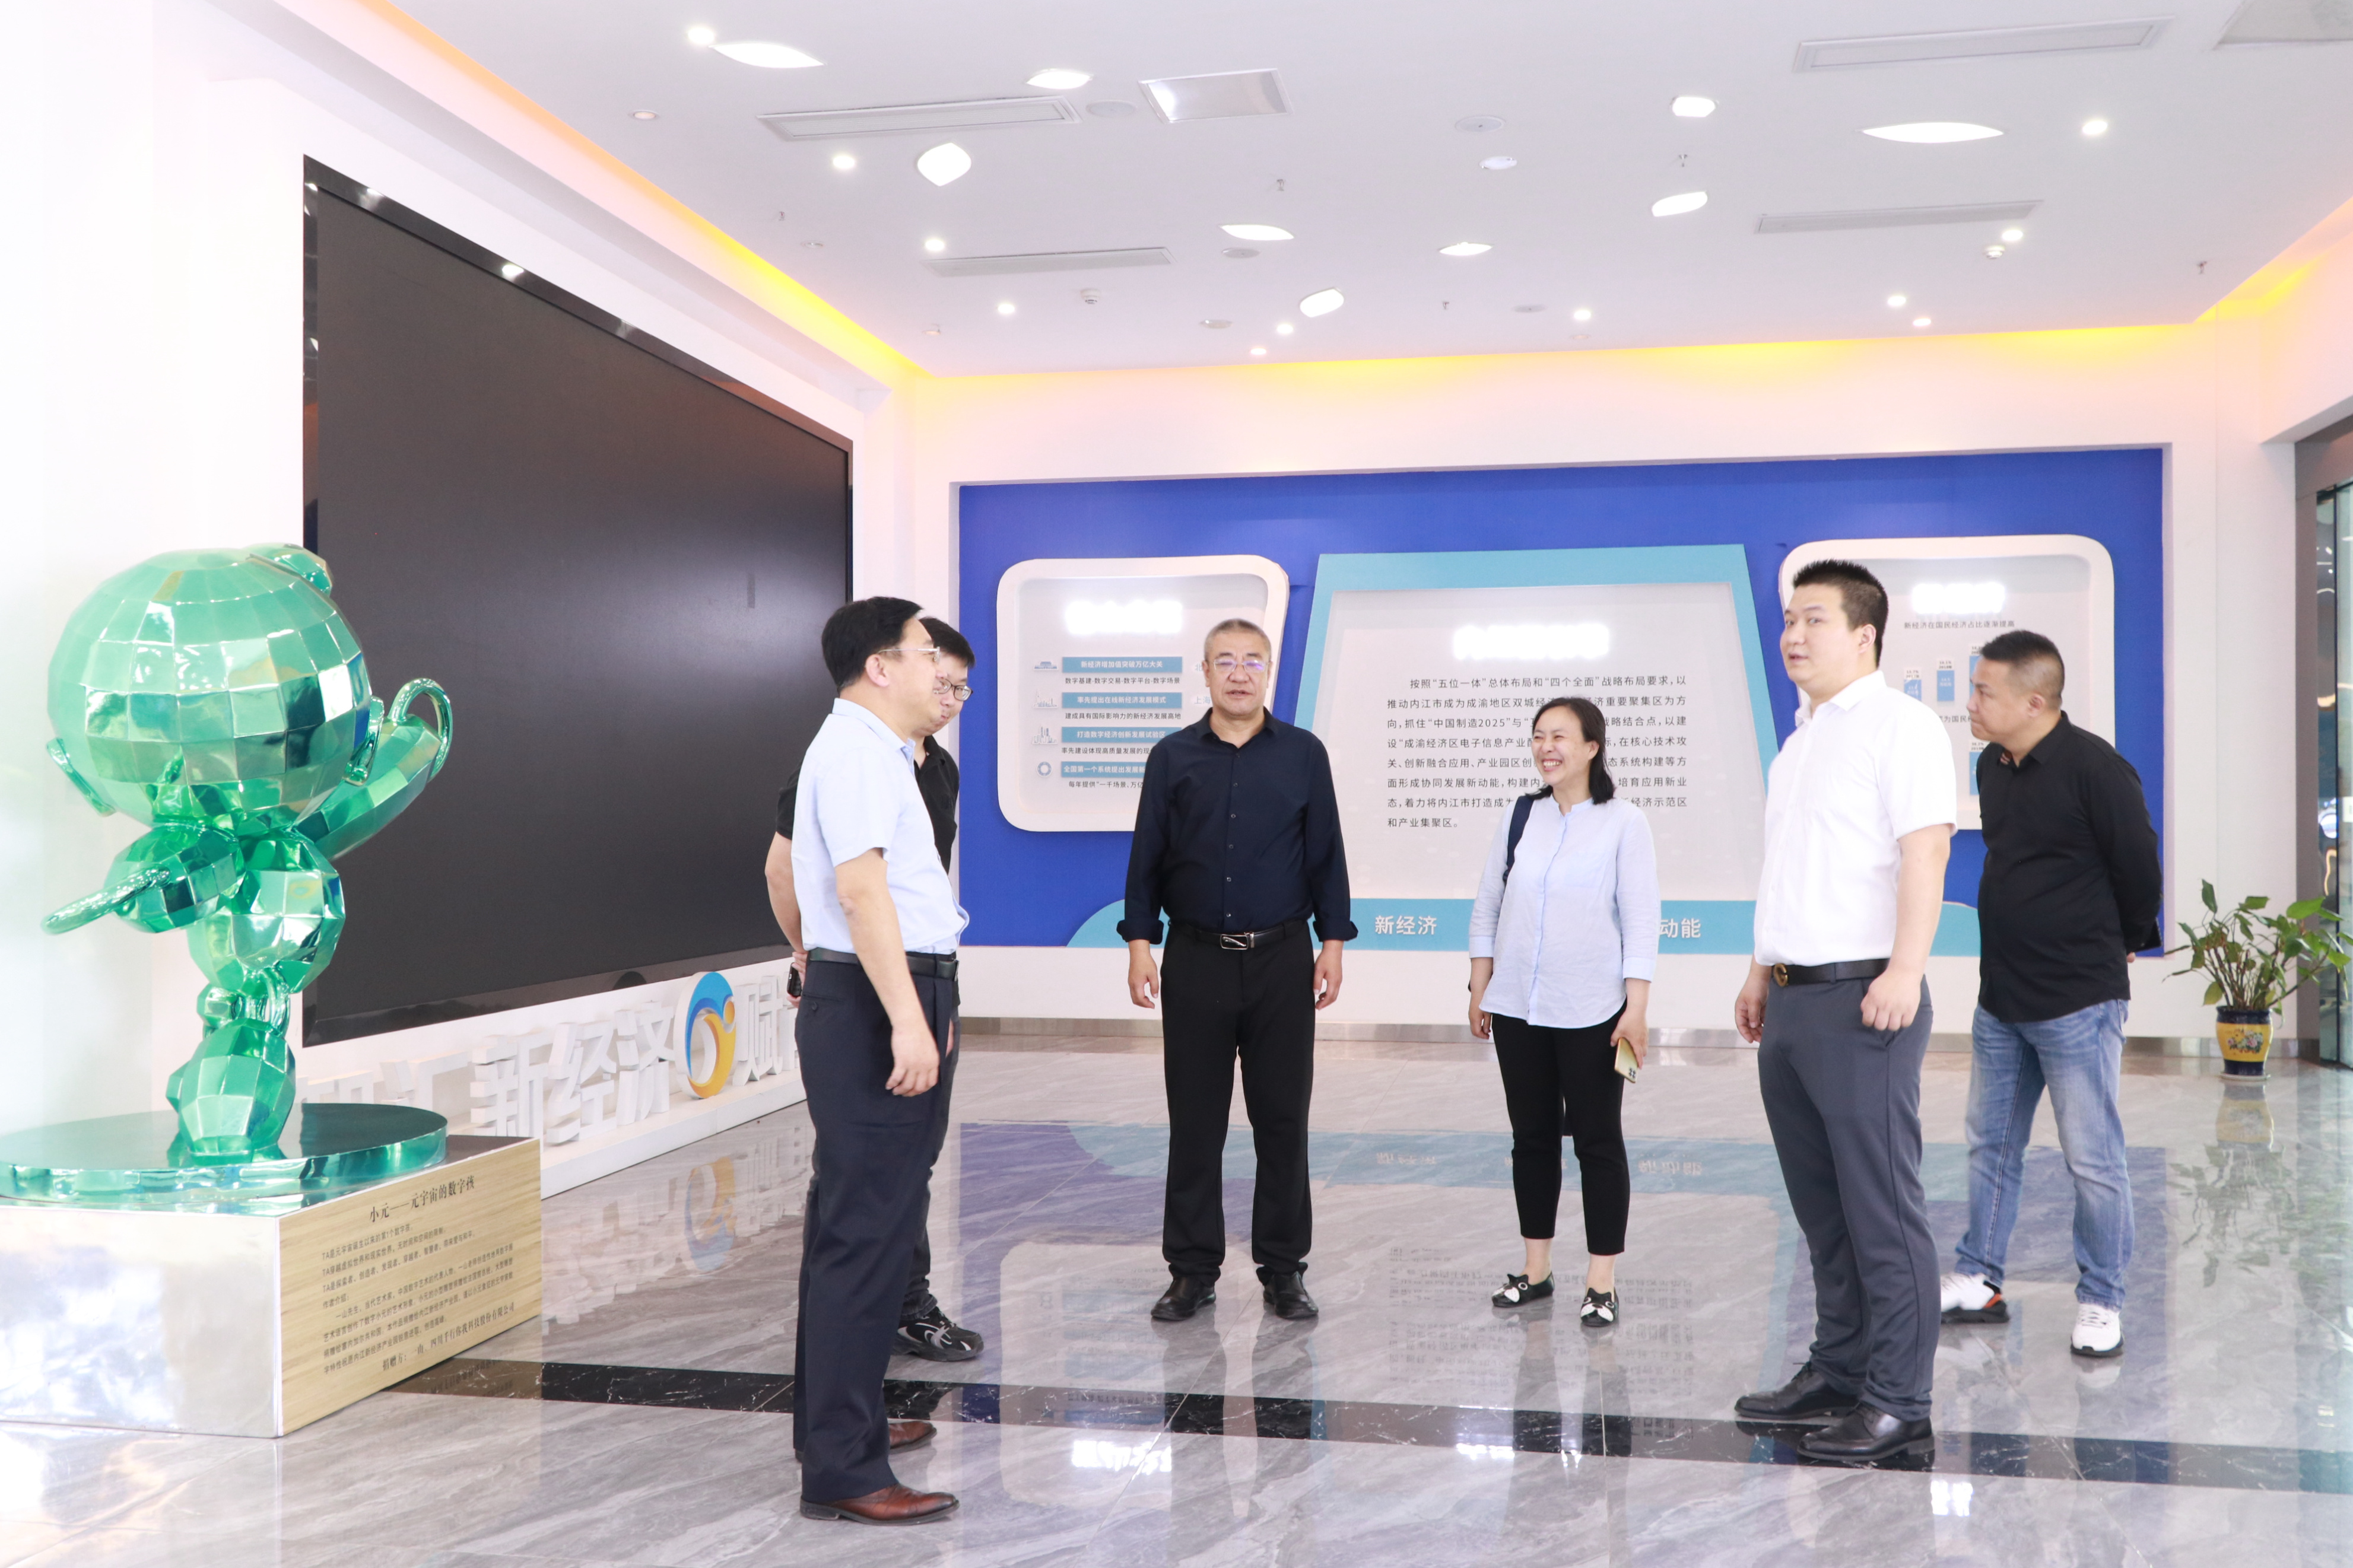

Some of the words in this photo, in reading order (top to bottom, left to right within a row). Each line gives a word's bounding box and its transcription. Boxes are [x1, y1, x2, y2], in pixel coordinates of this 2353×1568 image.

[1194, 696, 1211, 704] 上海
[1608, 756, 1687, 766] 态系统构建等方
[1618, 777, 1687, 787] 培育应用新业
[1374, 915, 1437, 936] 新经济
[370, 1174, 474, 1223] 小元——元宇宙的数字孩
